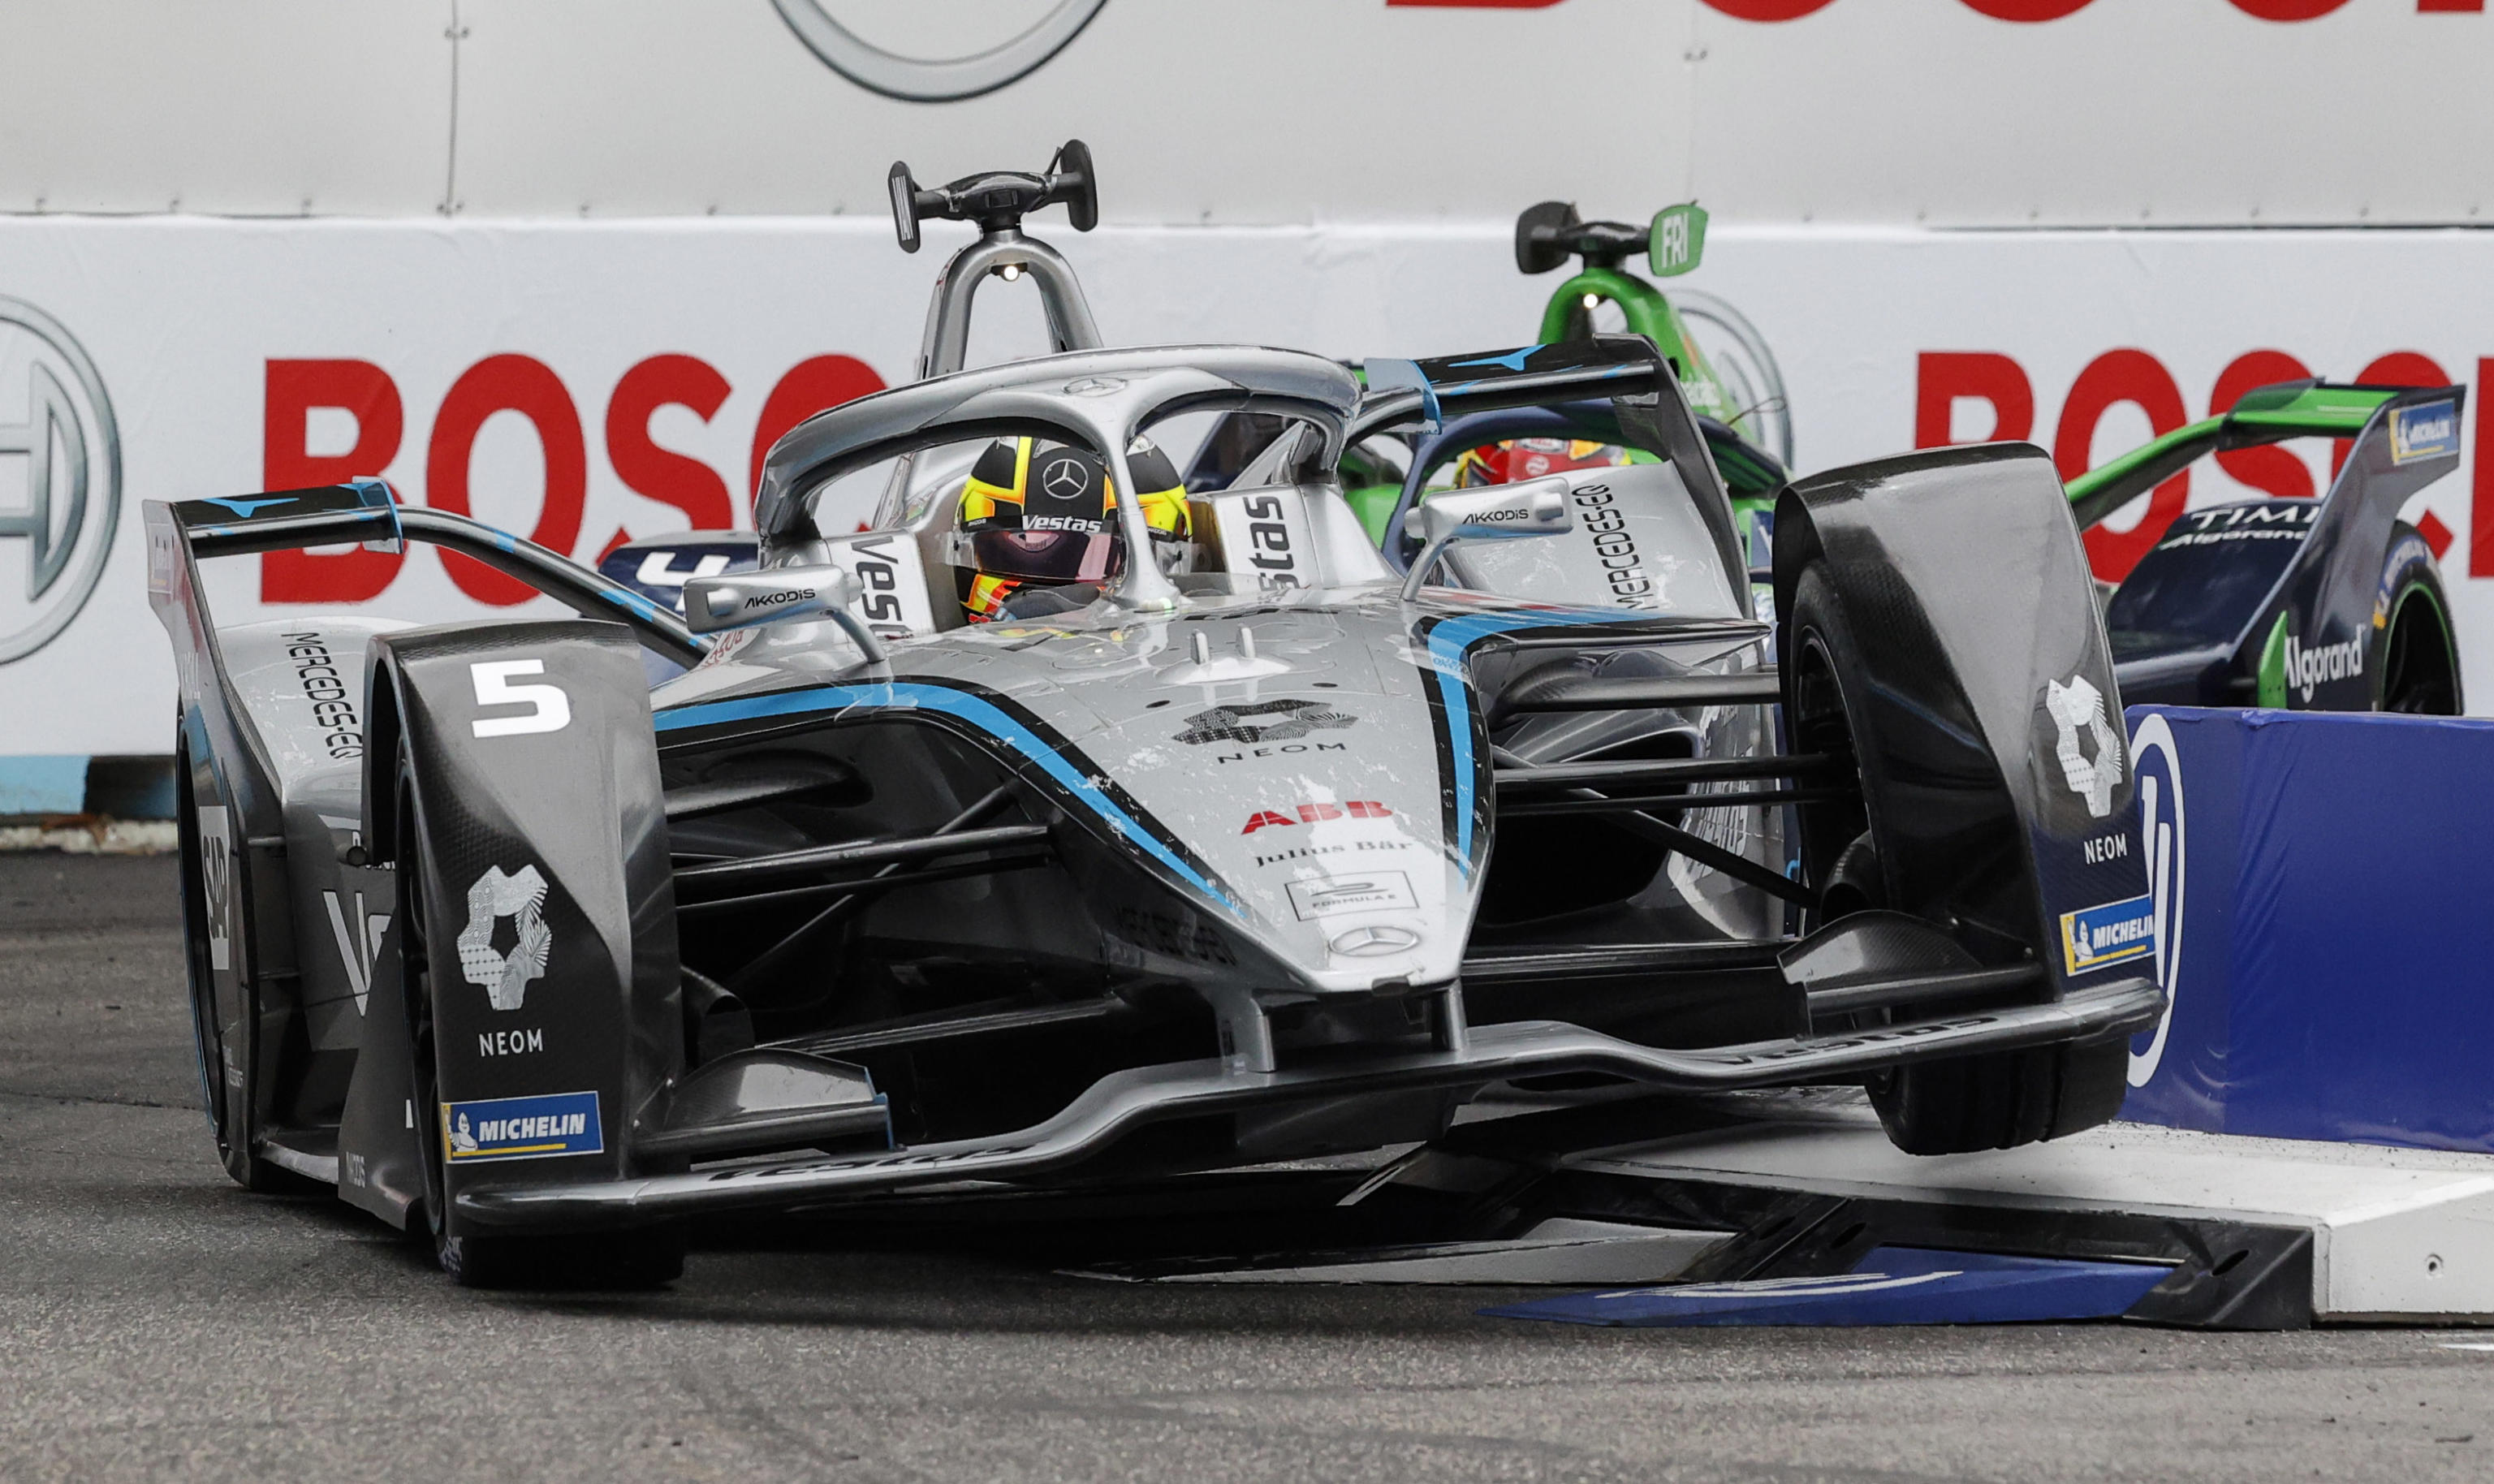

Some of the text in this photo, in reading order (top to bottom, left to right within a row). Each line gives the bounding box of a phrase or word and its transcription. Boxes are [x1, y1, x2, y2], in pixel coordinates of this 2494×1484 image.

[1661, 212, 1689, 268] FRI
[1022, 514, 1103, 533] Vestas
[469, 658, 572, 738] 5
[1218, 742, 1347, 765] NEOM
[1241, 800, 1393, 835] ABB
[1256, 844, 1346, 868] Julius
[2083, 832, 2128, 865] NEOM
[1312, 894, 1385, 908] FORMULA
[478, 1028, 544, 1057] NEOM
[478, 1113, 585, 1142] MICHELIN
